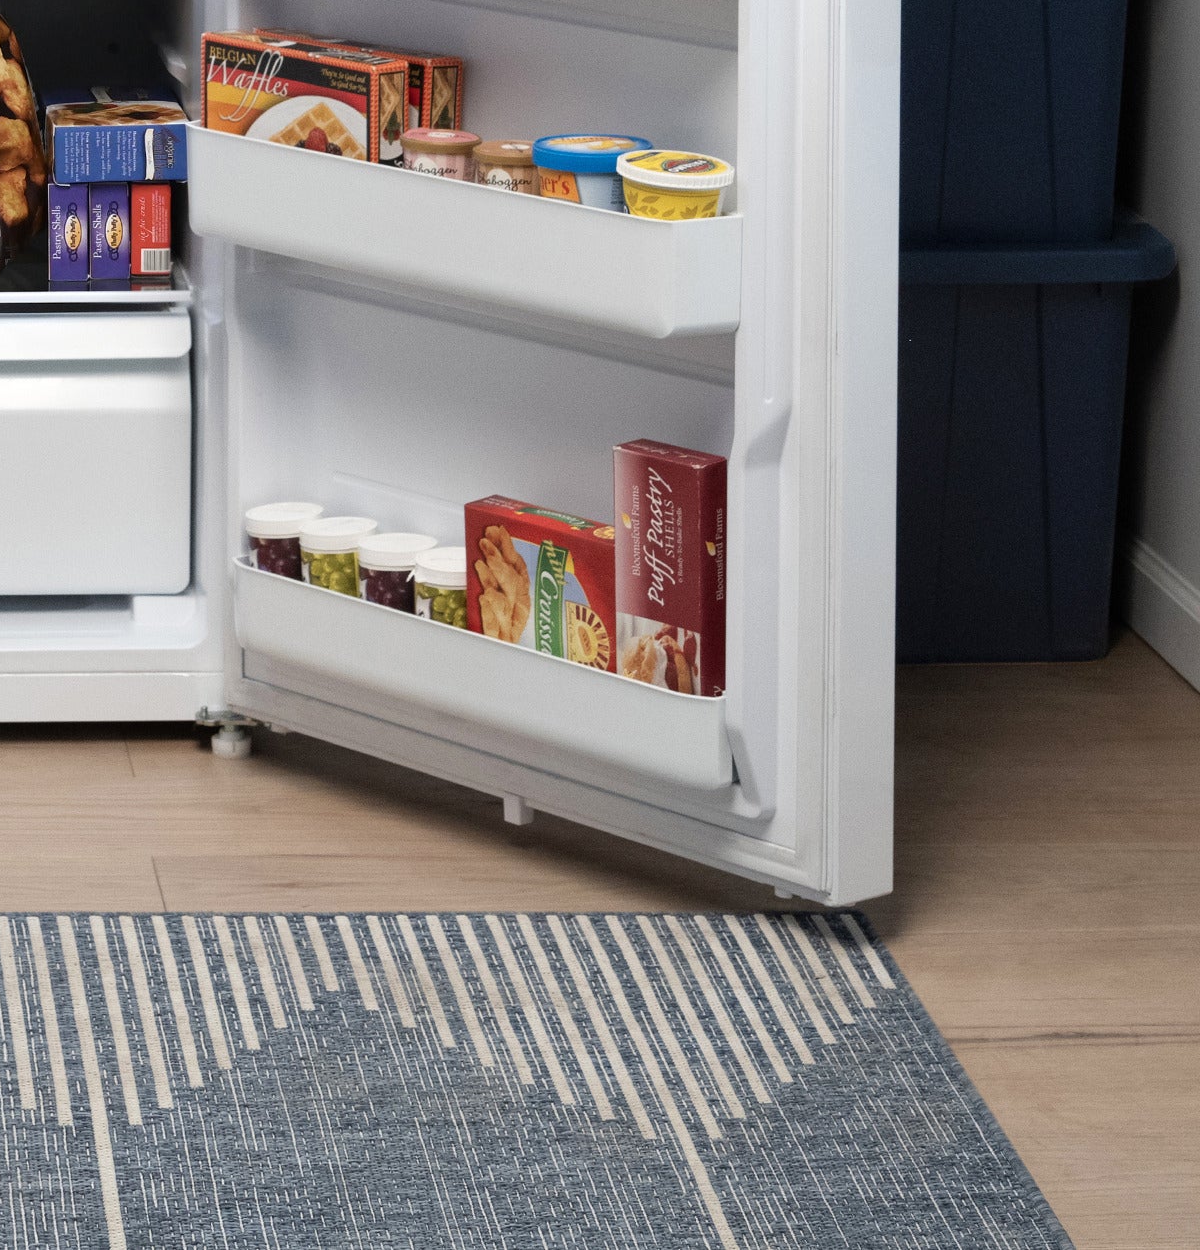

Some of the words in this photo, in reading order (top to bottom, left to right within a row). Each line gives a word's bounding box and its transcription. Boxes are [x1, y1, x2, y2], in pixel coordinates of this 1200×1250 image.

[209, 46, 257, 66] BELGIAN
[207, 49, 289, 122] Waffles
[164, 136, 175, 169] organic
[51, 205, 61, 230] Shells
[93, 204, 102, 229] Shells
[52, 232, 63, 260] Pastry
[93, 231, 104, 258] Pastry
[631, 485, 640, 517] Farms
[646, 466, 673, 548] Pastry
[664, 499, 675, 559] SHELLS
[715, 508, 724, 540] Farms
[632, 519, 641, 577] Bloomsford
[643, 545, 676, 607] Puff
[715, 541, 724, 601] Bloomsford
